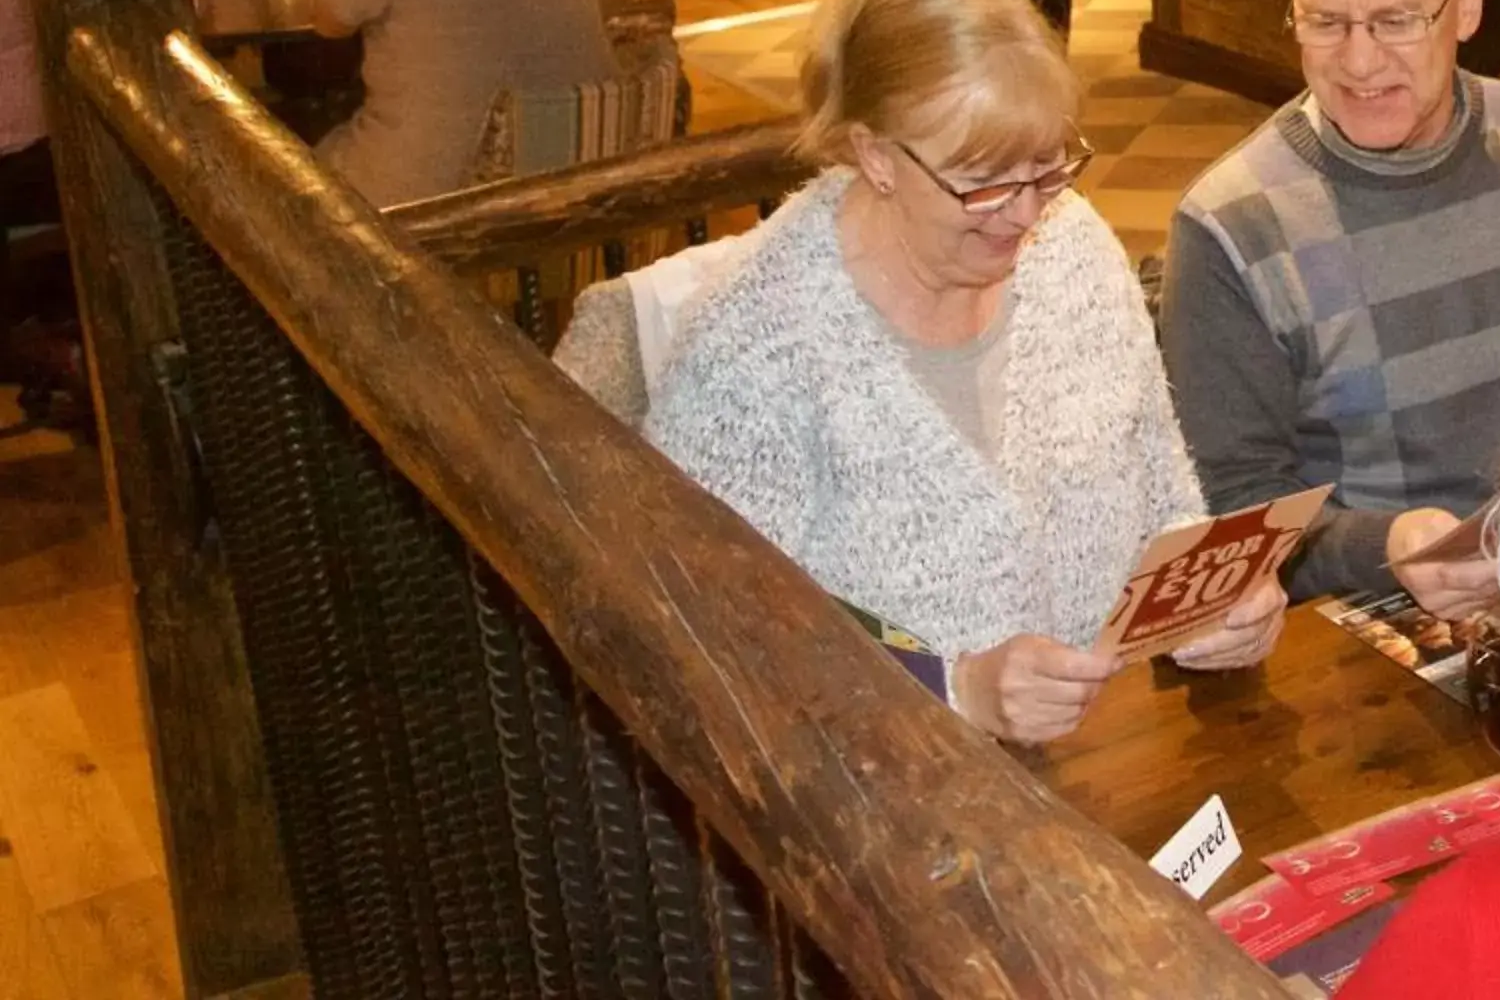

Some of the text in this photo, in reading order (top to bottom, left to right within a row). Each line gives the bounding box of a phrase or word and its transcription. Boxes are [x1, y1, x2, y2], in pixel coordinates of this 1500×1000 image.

[1162, 534, 1266, 581] 2 FOR
[1152, 558, 1250, 614] £10
